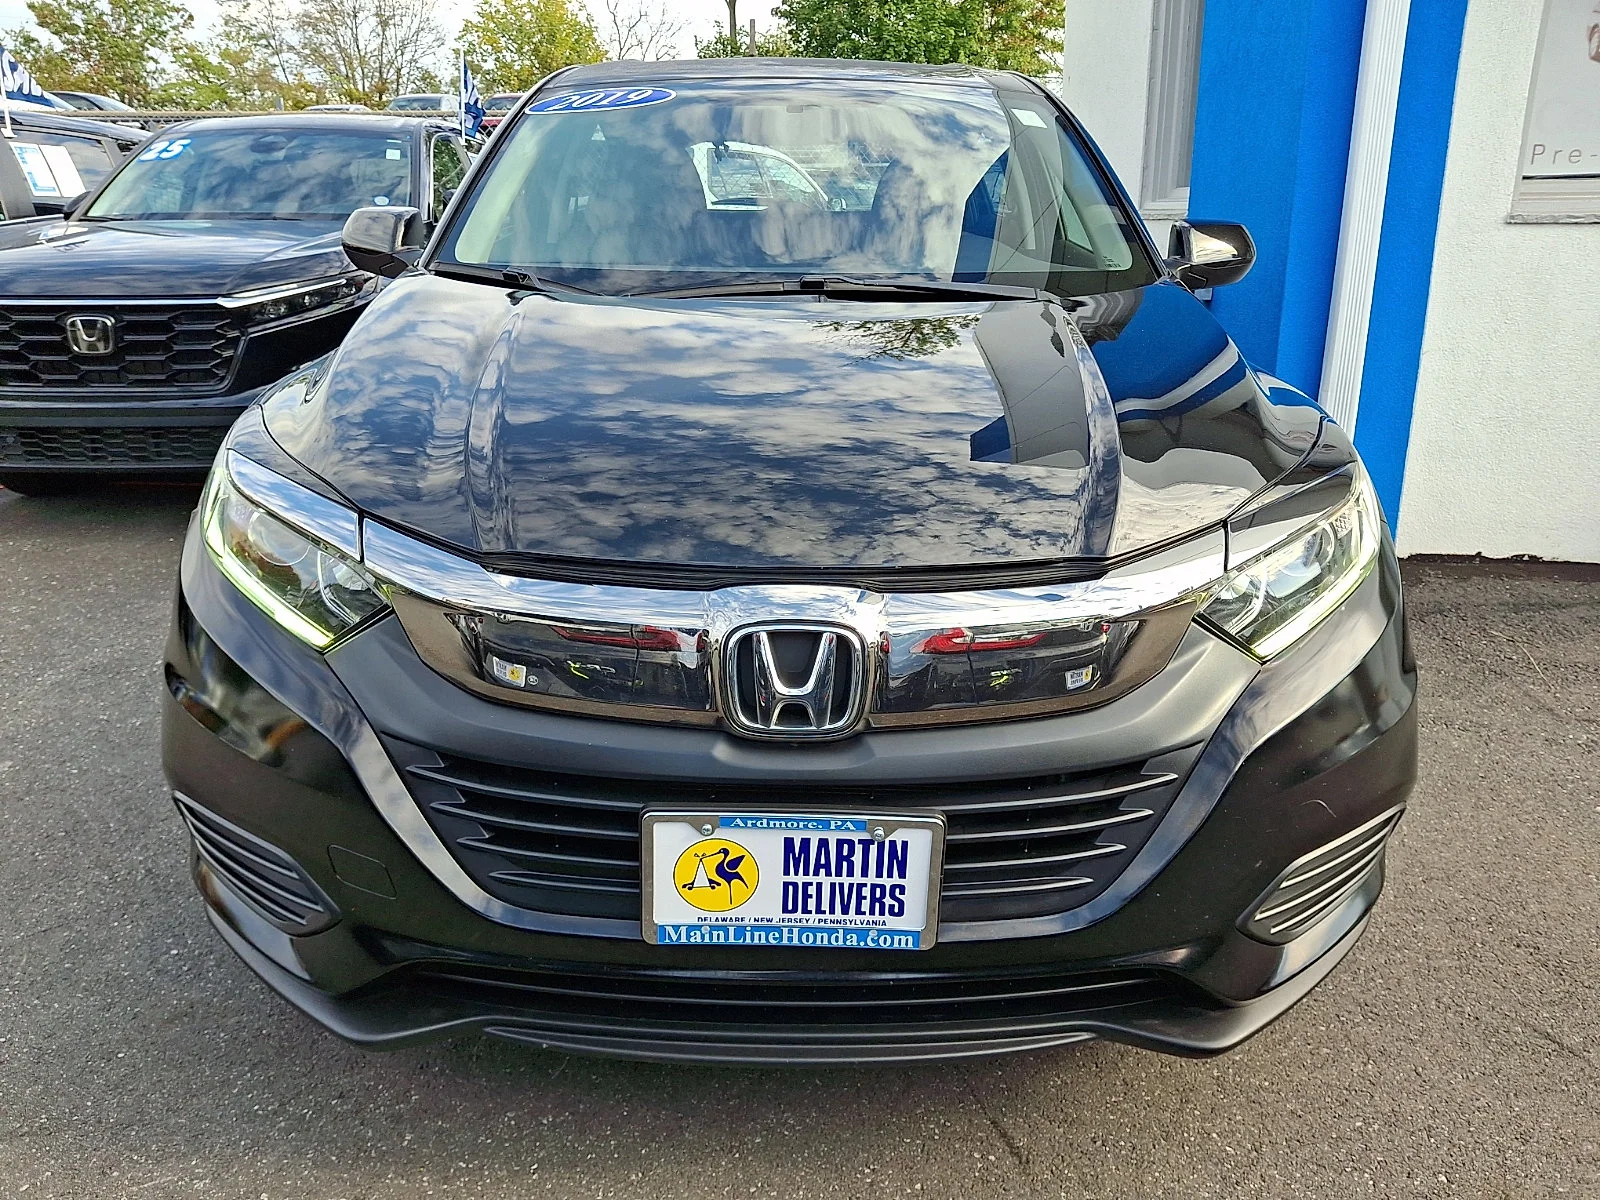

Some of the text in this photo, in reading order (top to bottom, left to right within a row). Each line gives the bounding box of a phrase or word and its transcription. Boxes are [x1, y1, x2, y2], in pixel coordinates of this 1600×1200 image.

[544, 89, 654, 112] 2019
[138, 138, 192, 161] 25
[829, 819, 857, 831] PA
[782, 836, 909, 880] MARTIN
[781, 881, 905, 918] DELIVERS
[776, 917, 811, 925] JERSEY
[817, 918, 887, 927] PENNSYLVANIA
[664, 924, 914, 949] MainLineHonda.com
